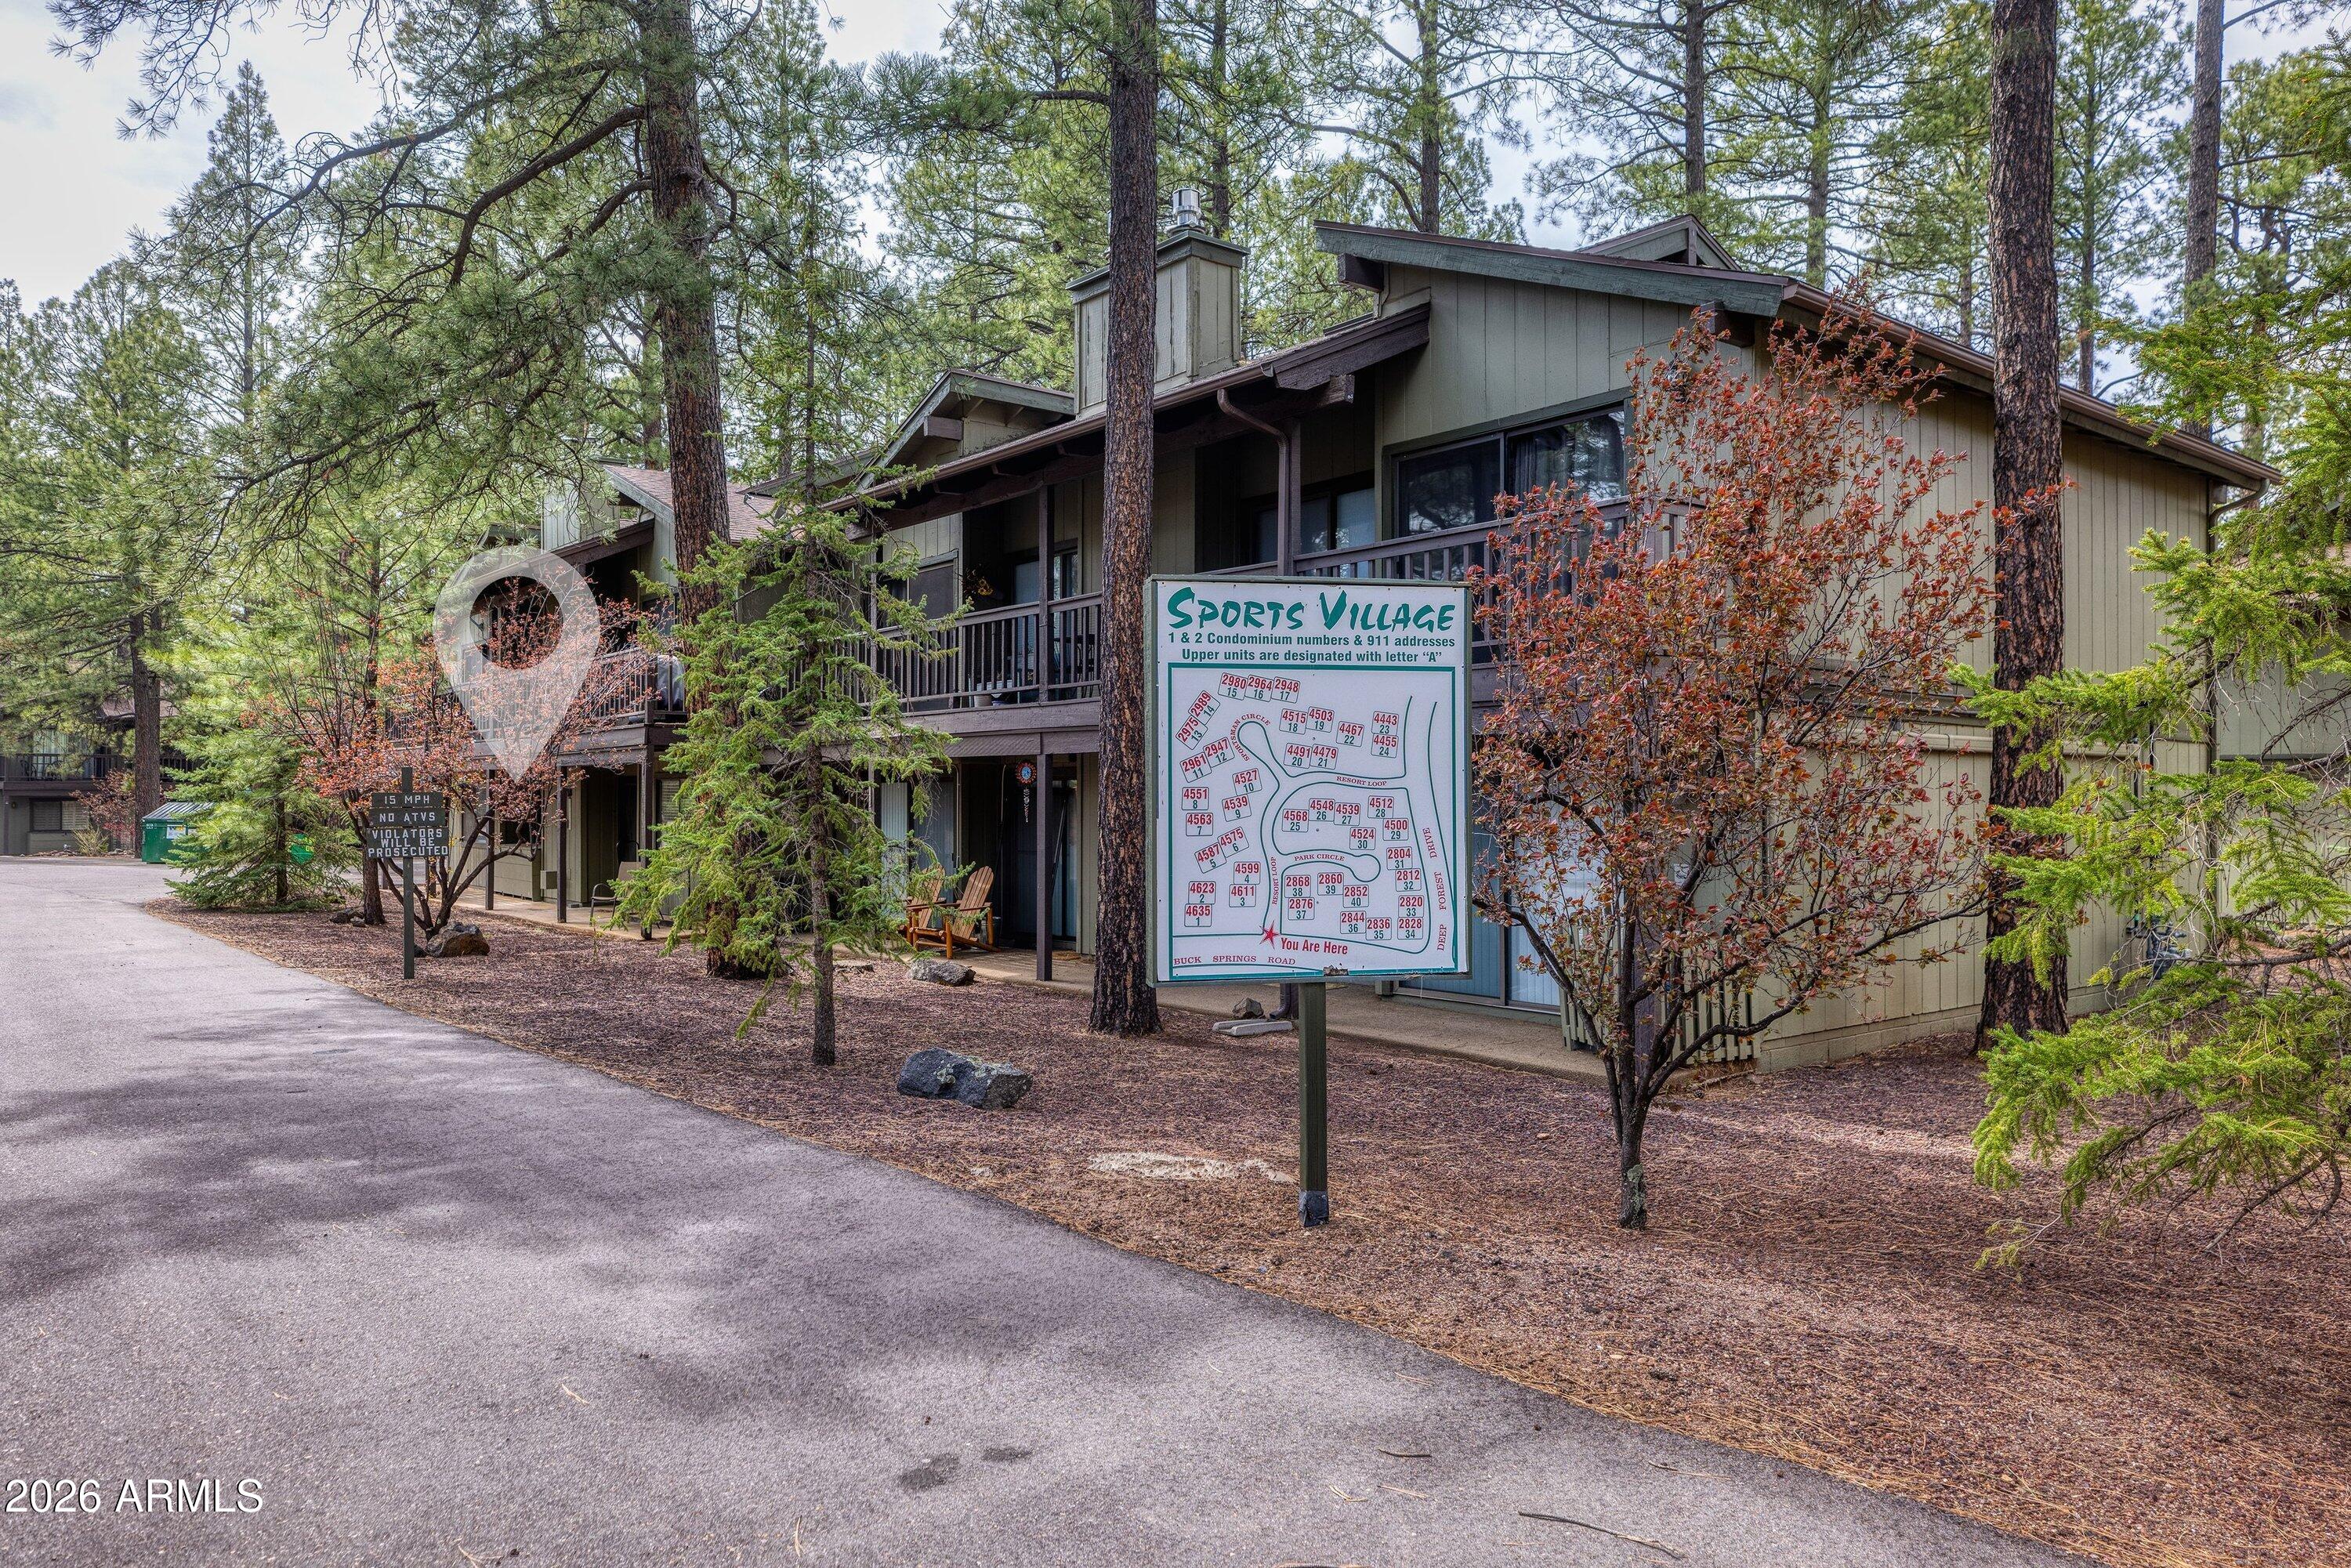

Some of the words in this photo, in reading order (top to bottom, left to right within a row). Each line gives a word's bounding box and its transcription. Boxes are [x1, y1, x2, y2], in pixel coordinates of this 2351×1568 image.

[1168, 587, 1305, 630] SPORTS
[1320, 590, 1455, 633] VILLAGE
[1168, 632, 1174, 643] 1
[1181, 632, 1190, 643] &
[1195, 632, 1202, 643] 2
[1208, 632, 1292, 645] Condominium
[1297, 634, 1349, 646] numbers
[1354, 635, 1362, 645] &
[1367, 636, 1389, 646] 911
[1395, 636, 1455, 646] addresses
[1182, 649, 1219, 662] Upper
[1224, 650, 1255, 661] units
[1259, 652, 1279, 661] are
[1284, 650, 1352, 663] designated
[1357, 651, 1382, 662] with
[1386, 651, 1418, 662] letter
[1423, 652, 1442, 662] “A”
[1222, 674, 1247, 690] 2980
[1248, 676, 1273, 691] 2964
[1274, 679, 1299, 693] 2948
[1227, 687, 1237, 697] 15
[1254, 689, 1263, 699] 16
[1280, 691, 1290, 701] 17
[1190, 692, 1212, 717] 2989
[1204, 705, 1215, 717] 14
[1309, 708, 1332, 722] 4503
[1282, 711, 1306, 724] 4515
[1374, 713, 1397, 726] 4443
[1178, 717, 1199, 742] 2975
[1288, 722, 1298, 732] 18
[1314, 720, 1324, 730] 19
[1339, 723, 1363, 736] 4467
[1379, 725, 1389, 734] 23
[1191, 730, 1203, 742] 13
[1230, 719, 1250, 761] SPORTSMAN
[1241, 713, 1270, 726] CIRCLE
[1344, 735, 1354, 744] 22
[1374, 735, 1396, 747] 4455
[1205, 739, 1229, 757] 2947
[1288, 745, 1310, 758] 4491
[1313, 746, 1337, 759] 4479
[1379, 747, 1389, 755] 24
[1215, 751, 1226, 763] 12
[1291, 757, 1302, 766] 20
[1182, 754, 1207, 773] 2961
[1318, 758, 1328, 767] 21
[1193, 767, 1204, 779] 11
[1234, 770, 1257, 784] 4527
[1336, 776, 1366, 786] RESORT
[1244, 783, 1254, 792] 10
[1184, 789, 1207, 799] 4551
[385, 795, 396, 804] 15
[404, 795, 429, 804] MPH
[1193, 800, 1197, 809] 8
[1224, 796, 1248, 811] 4539
[1370, 798, 1393, 809] 4512
[1310, 800, 1334, 811] 4548
[1336, 804, 1360, 815] 4539
[379, 813, 394, 822] NO
[404, 812, 436, 822] ATVS
[1235, 809, 1241, 819] 9
[1284, 810, 1307, 821] 4568
[1317, 811, 1326, 820] 26
[1375, 809, 1386, 817] 28
[1187, 814, 1212, 824] 4563
[1342, 816, 1352, 824] 27
[1290, 822, 1300, 831] 25
[1385, 820, 1407, 830] 4500
[371, 829, 442, 839] VIOLATORS
[1197, 826, 1202, 835] 7
[1351, 828, 1375, 839] 4524
[1391, 831, 1400, 839] 29
[1220, 828, 1244, 847] 4575
[1422, 827, 1437, 858] DRIVE
[381, 838, 411, 848] WILL
[420, 838, 435, 846] BE
[1233, 843, 1239, 853] 6
[1357, 840, 1367, 849] 30
[368, 846, 448, 857] PROSECUTED
[1197, 844, 1220, 862] 4587
[1388, 848, 1411, 859] 2804
[1210, 859, 1216, 868] 5
[1235, 863, 1259, 874] 4599
[1395, 860, 1404, 868] 31
[1244, 875, 1249, 883] 4
[1319, 874, 1342, 884] 2860
[1396, 870, 1420, 881] 2812
[1286, 876, 1310, 887] 2868
[1404, 882, 1414, 890] 32
[1190, 883, 1215, 893] 4623
[1231, 885, 1255, 896] 4611
[1292, 887, 1302, 896] 38
[1325, 885, 1335, 894] 39
[1344, 886, 1367, 896] 2852
[1434, 871, 1447, 911] FOREST
[1200, 894, 1204, 903] 2
[1241, 897, 1245, 906] 3
[1351, 897, 1361, 907] 40
[1400, 896, 1423, 907] 2820
[1289, 899, 1313, 909] 2876
[1186, 906, 1210, 916] 4635
[1296, 911, 1306, 919] 37
[1406, 907, 1416, 917] 33
[1196, 917, 1200, 925] 1
[1341, 912, 1364, 923] 2844
[1349, 924, 1358, 932] 36
[1367, 918, 1390, 929] 2836
[1399, 918, 1422, 929] 2828
[1374, 930, 1384, 939] 35
[1405, 929, 1415, 938] 34
[1437, 924, 1447, 951] DEEP
[1281, 938, 1299, 951] You
[1302, 940, 1320, 952] Are
[1324, 941, 1348, 954] Here
[1174, 956, 1201, 965] BUCK
